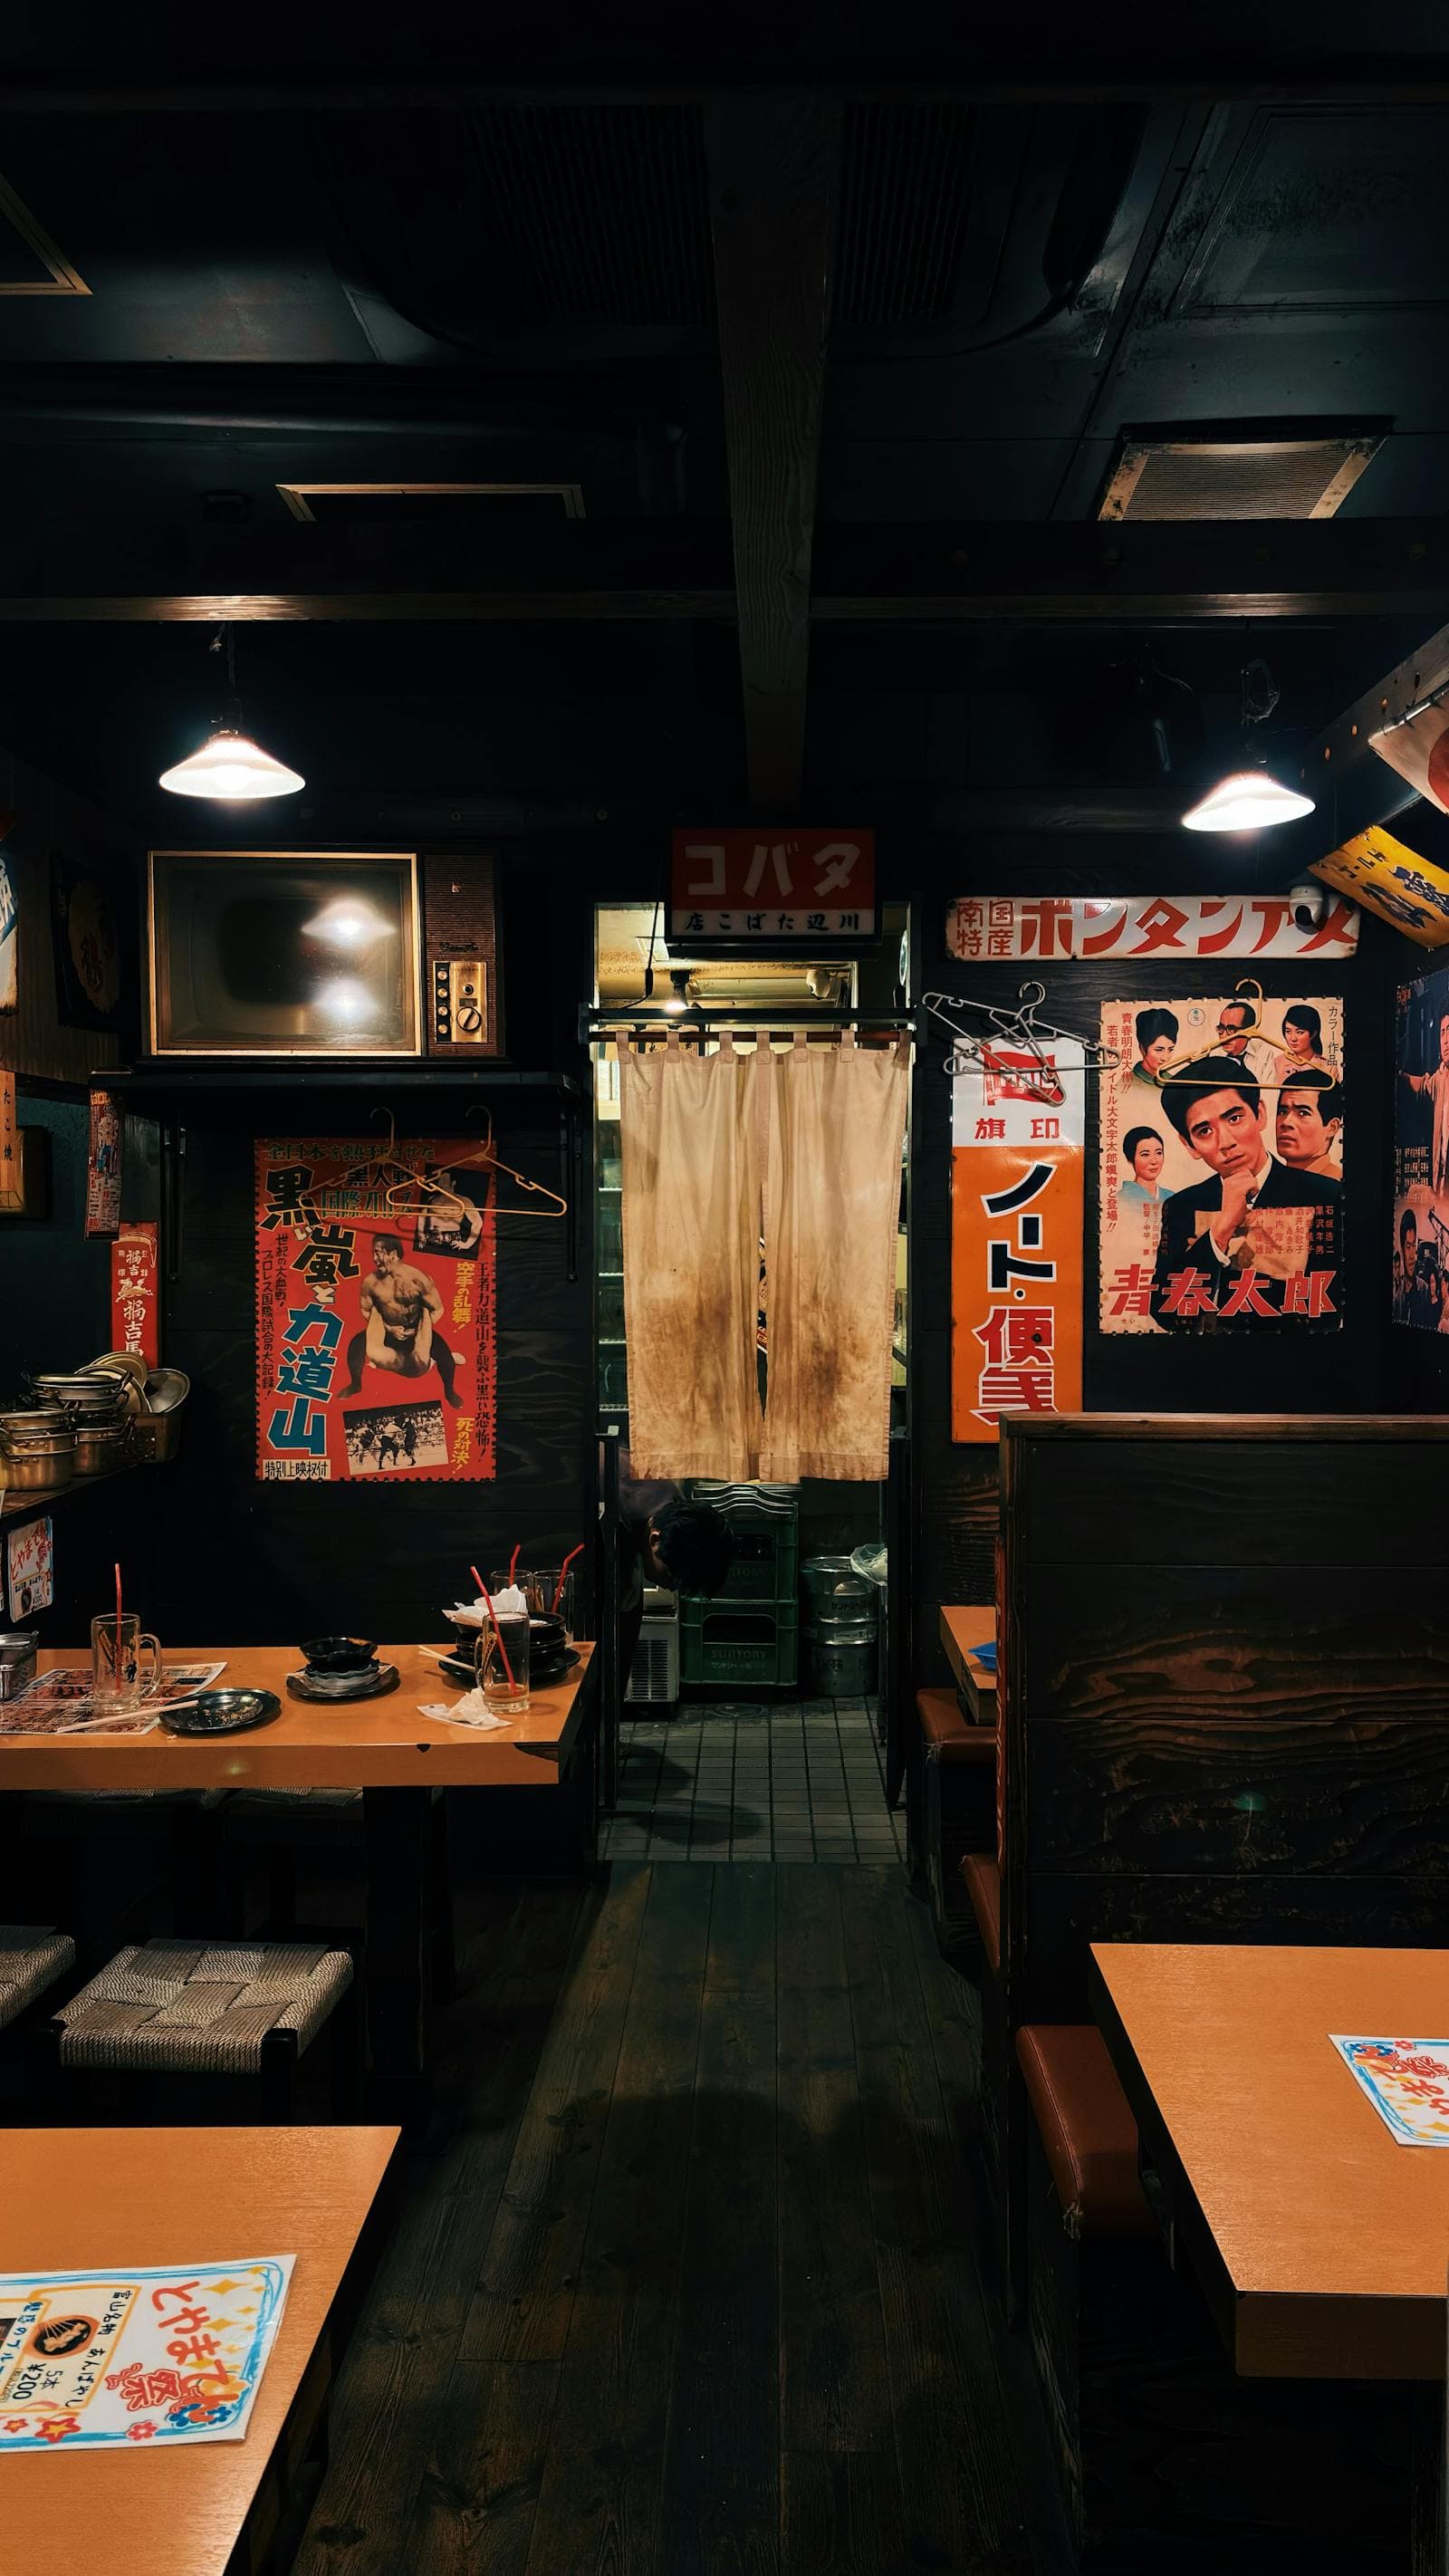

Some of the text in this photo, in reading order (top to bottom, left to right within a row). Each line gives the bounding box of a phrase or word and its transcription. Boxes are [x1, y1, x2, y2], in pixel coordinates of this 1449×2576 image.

[1327, 1005, 1339, 1066] カラー作品
[1325, 1205, 1335, 1254] 石坂浩二
[1108, 1264, 1339, 1318] 青春太郎
[64, 2347, 106, 2408] あんばやし
